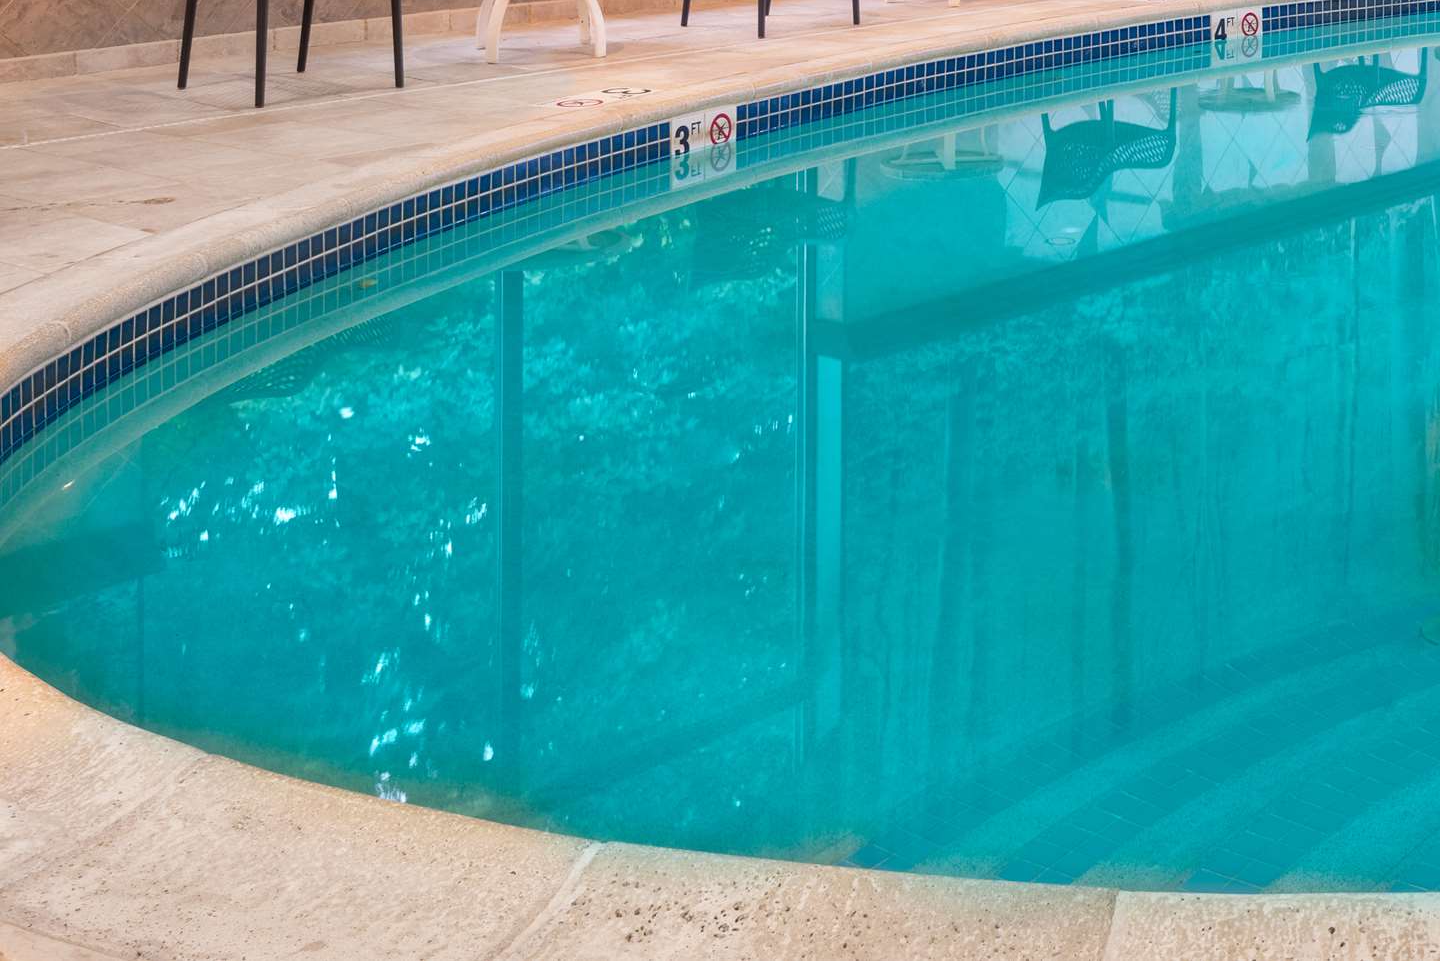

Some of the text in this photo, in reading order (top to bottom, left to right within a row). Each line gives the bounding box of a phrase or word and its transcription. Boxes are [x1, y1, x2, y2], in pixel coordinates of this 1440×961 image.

[1214, 16, 1236, 41] 4 FT
[675, 121, 702, 156] 3 FT
